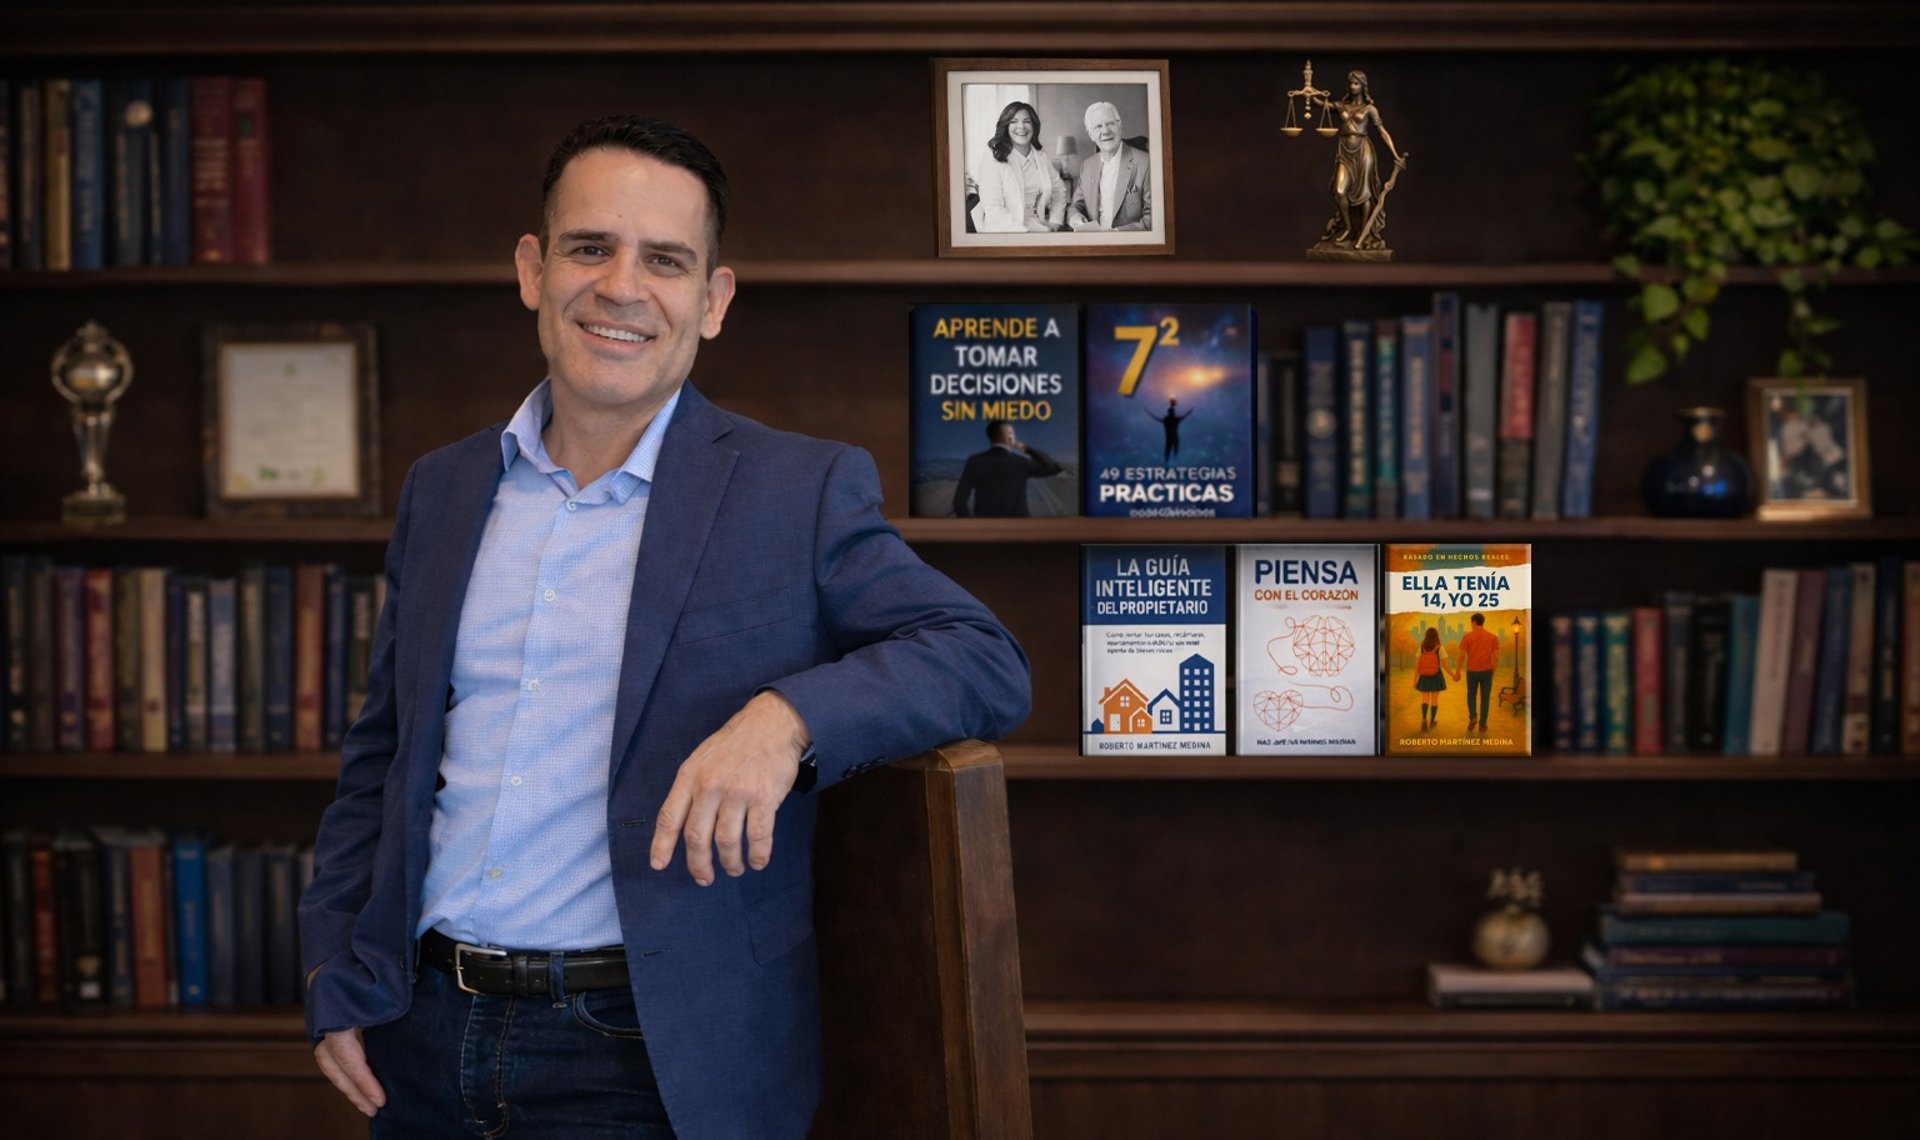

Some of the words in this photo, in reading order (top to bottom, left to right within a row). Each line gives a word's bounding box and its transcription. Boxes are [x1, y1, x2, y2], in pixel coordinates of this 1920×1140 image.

[933, 317, 1038, 339] APRENDE
[1043, 317, 1060, 338] A
[954, 345, 1038, 367] TOMAR
[930, 373, 1063, 395] DECISIONES
[942, 401, 976, 421] SIN
[982, 401, 1052, 421] MIEDO
[1099, 467, 1120, 480] 49
[1125, 466, 1237, 480] ESTRATEGIAS
[1117, 558, 1140, 576] LA
[1145, 554, 1190, 576] GUÍA
[1255, 559, 1358, 585] PIENSA
[1096, 579, 1212, 597] INTELIGENTE
[1402, 576, 1448, 591] ELLA
[1454, 571, 1511, 591] TENÍA
[1254, 589, 1281, 601] CON
[1285, 590, 1299, 601] EL
[1421, 593, 1446, 609] 14,
[1448, 593, 1473, 607] YO
[1478, 593, 1500, 607] 25
[1097, 601, 1118, 615] DEL
[1119, 600, 1208, 615] PROPIETARIO
[1099, 741, 1134, 750] ROBERTO
[1179, 741, 1211, 750] MEDINA
[1400, 738, 1438, 746] ROBERTO
[1482, 738, 1514, 746] MEDINA
